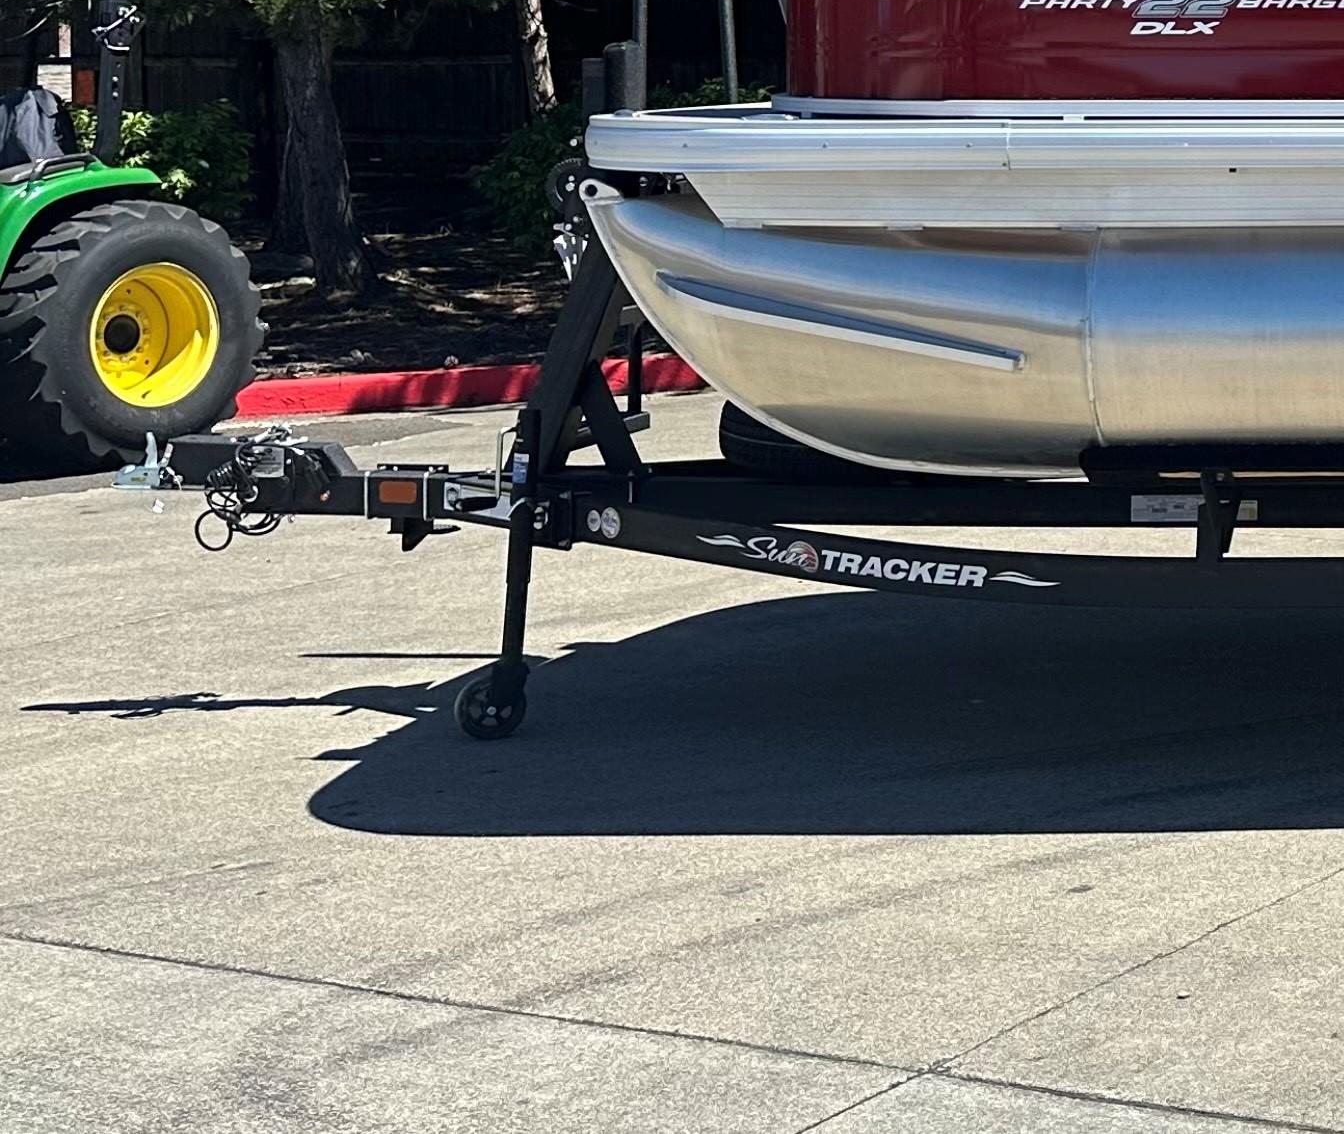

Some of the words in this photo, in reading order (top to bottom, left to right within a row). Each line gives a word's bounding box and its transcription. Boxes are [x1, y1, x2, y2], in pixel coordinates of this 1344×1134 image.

[1130, 20, 1221, 35] DLX
[740, 536, 809, 567] Sun
[820, 549, 988, 587] TRACKER
